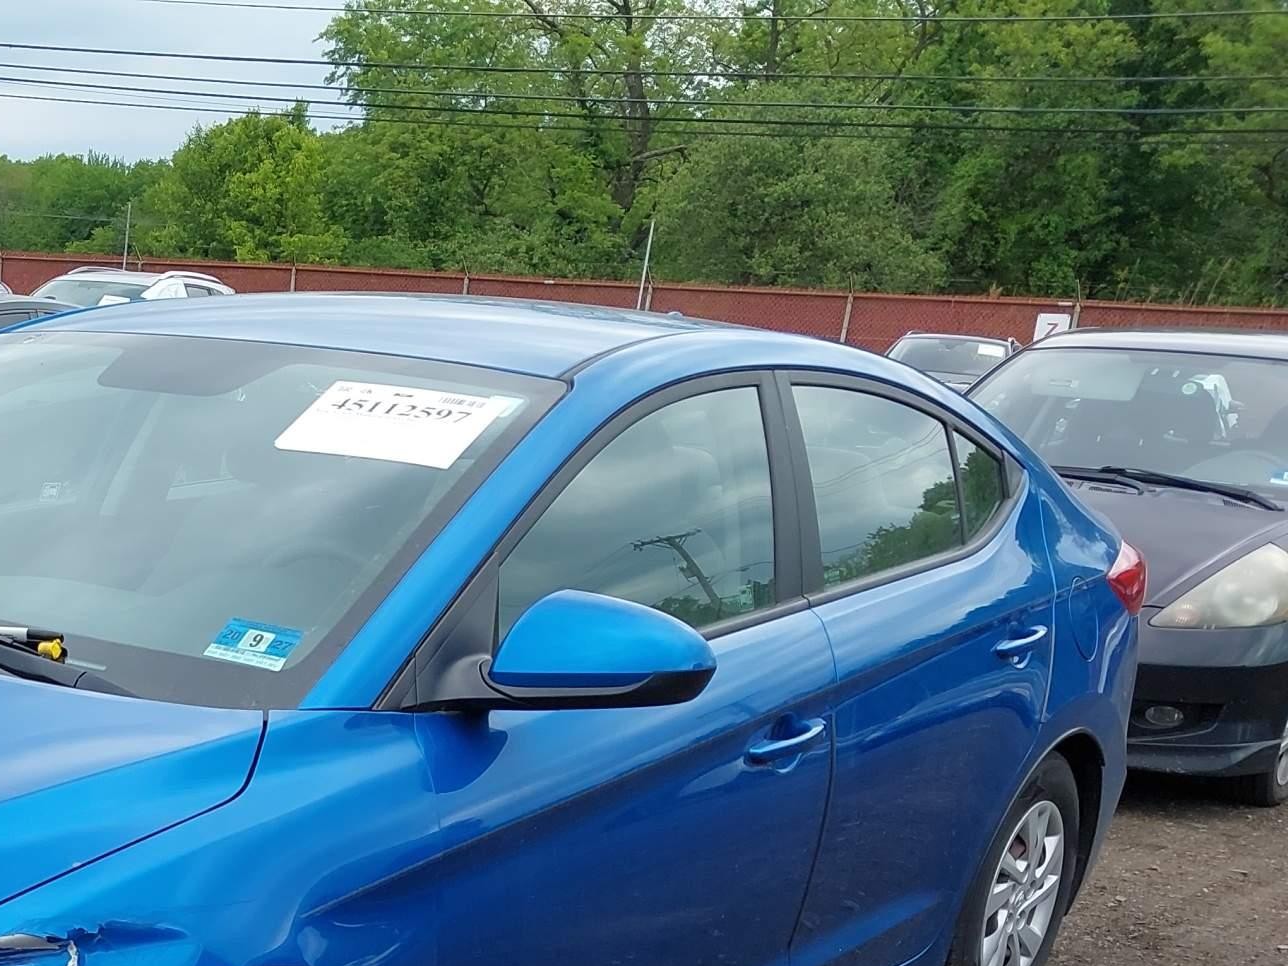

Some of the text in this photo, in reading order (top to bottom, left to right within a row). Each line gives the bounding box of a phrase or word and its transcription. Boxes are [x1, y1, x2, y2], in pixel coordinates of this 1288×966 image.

[331, 398, 472, 424] 45112597
[222, 629, 293, 650] 20 9 27
